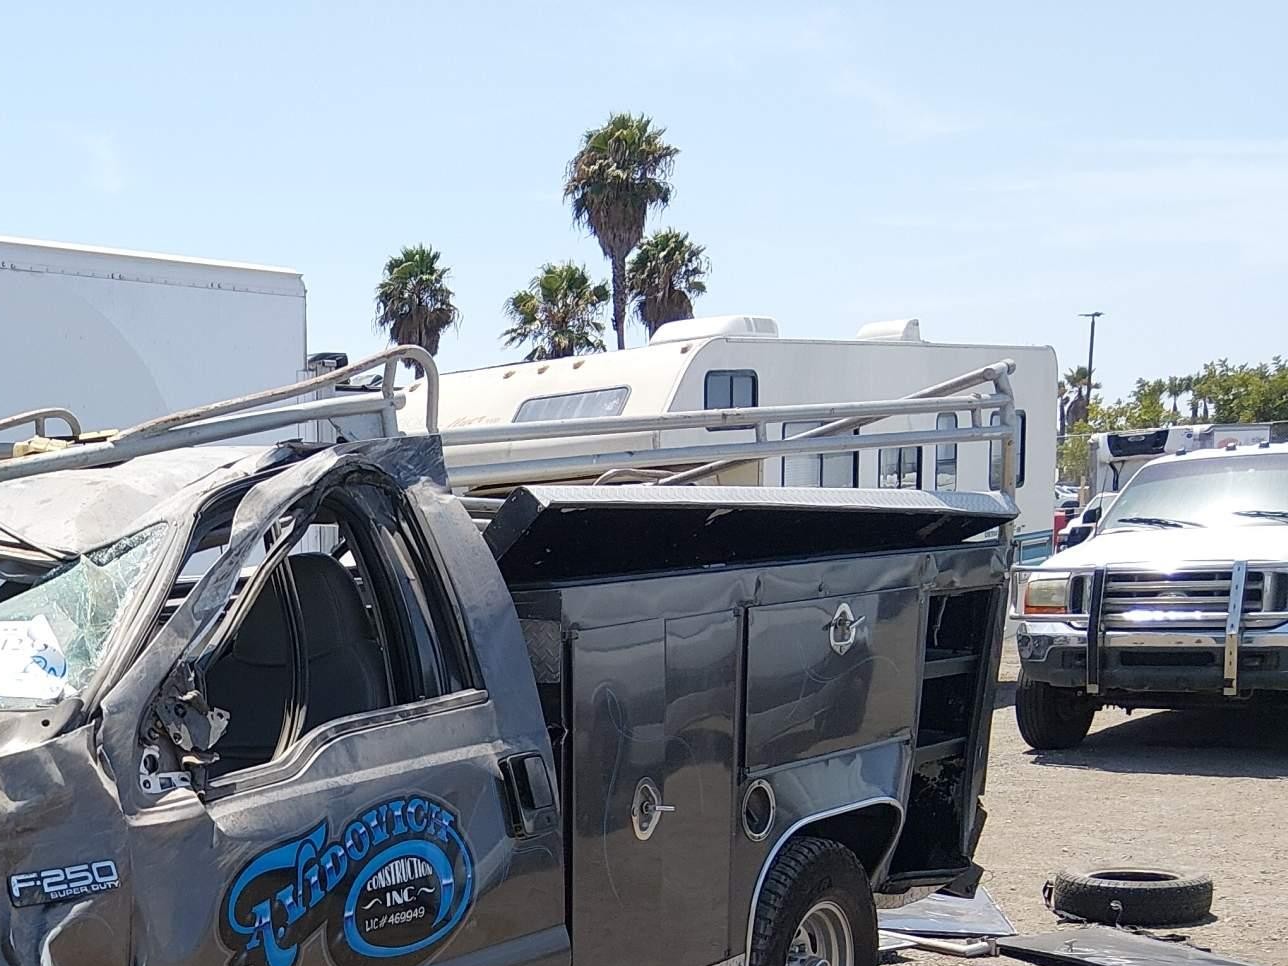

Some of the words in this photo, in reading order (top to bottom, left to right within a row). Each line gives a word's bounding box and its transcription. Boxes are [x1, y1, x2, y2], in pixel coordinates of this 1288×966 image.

[11, 860, 118, 897] F-250
[366, 857, 433, 892] CONSTRUCTION
[50, 886, 89, 899] SUPER
[92, 880, 121, 891] DUTY
[386, 886, 417, 907] INC.
